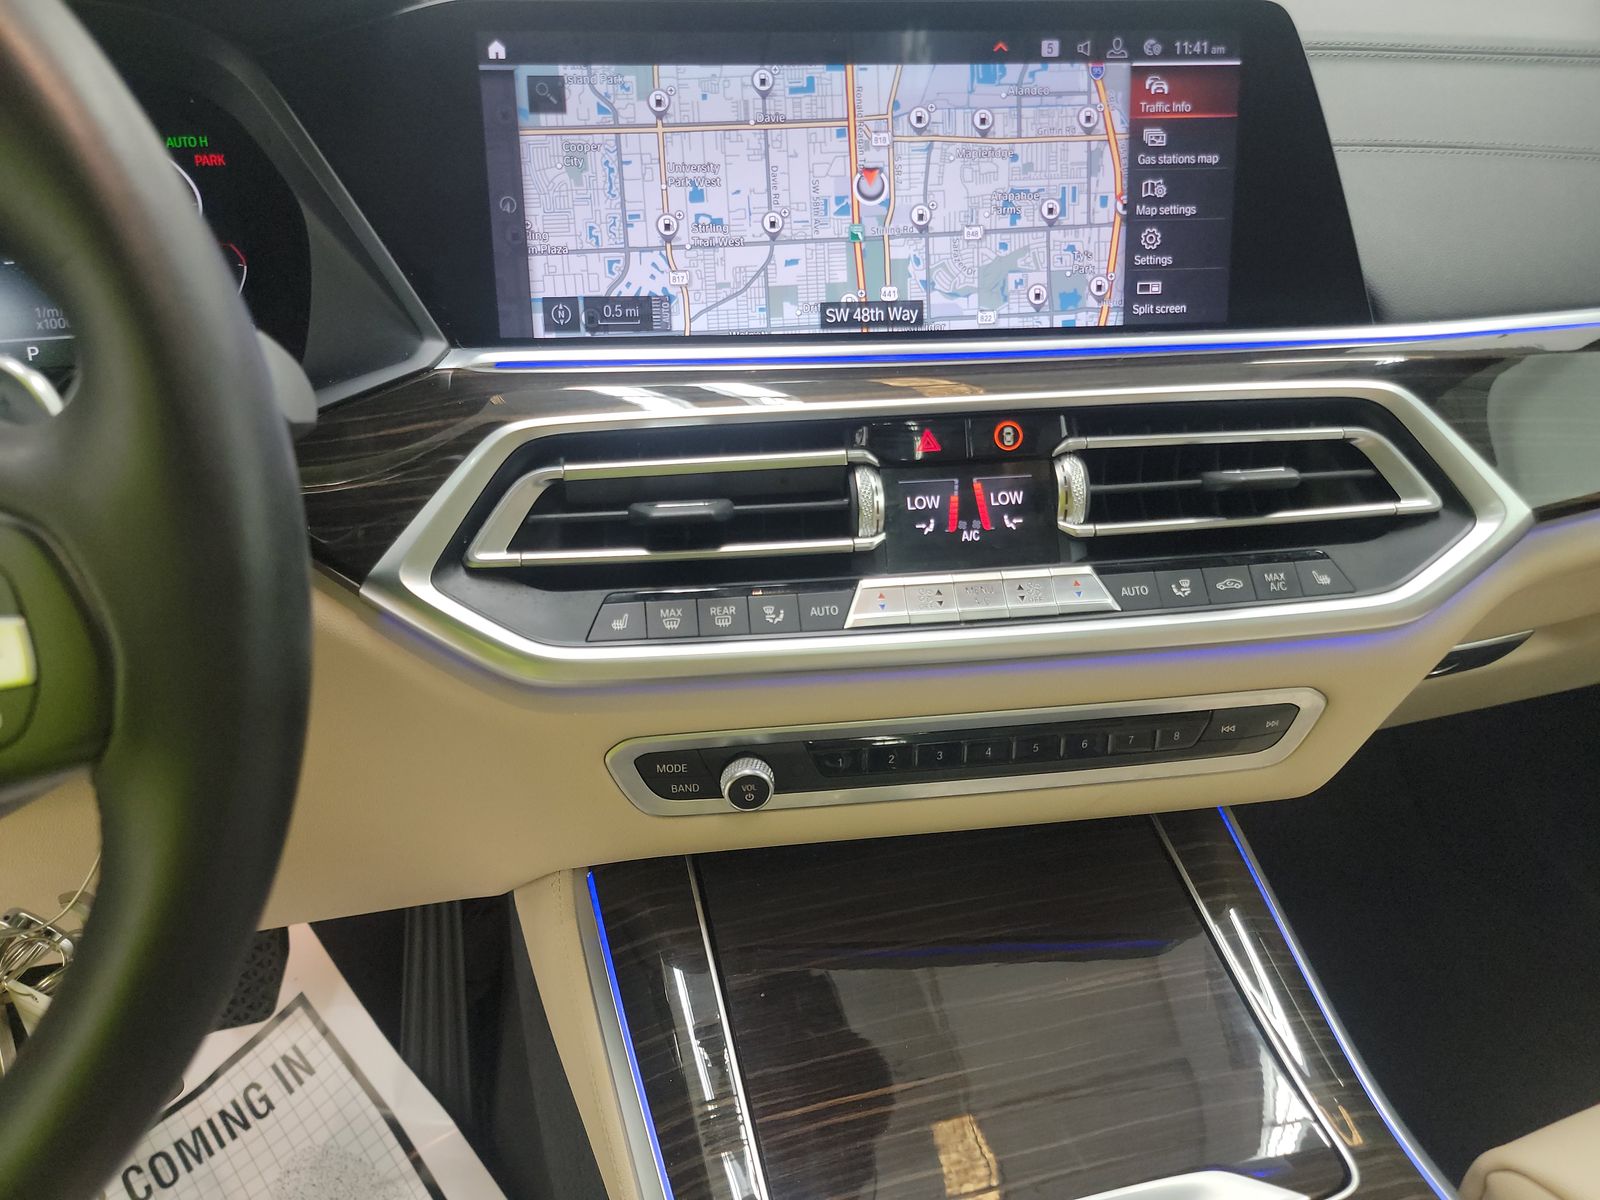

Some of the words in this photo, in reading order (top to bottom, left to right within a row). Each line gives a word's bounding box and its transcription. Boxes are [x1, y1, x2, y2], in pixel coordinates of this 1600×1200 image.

[1046, 42, 1054, 55] 5
[1174, 41, 1209, 55] 11:41
[1211, 46, 1226, 55] am
[600, 73, 625, 85] Park
[1139, 102, 1171, 113] Traffic
[1172, 101, 1192, 112] Info
[755, 112, 787, 123] Davie
[1037, 127, 1063, 136] Griffin
[1065, 127, 1077, 135] Rd
[166, 136, 197, 148] AUTO
[199, 136, 209, 148] H
[562, 141, 602, 154] Cooper
[956, 147, 1015, 160] Mapleridge
[194, 154, 226, 167] PARK
[563, 156, 585, 168] City
[1137, 154, 1157, 166] Gas
[1158, 154, 1196, 165] stations
[1197, 155, 1219, 165] map
[666, 162, 722, 176] University
[668, 176, 692, 188] Park
[693, 176, 722, 188] West
[770, 165, 780, 192] Davie
[811, 179, 821, 192] SW
[772, 193, 781, 206] Rd
[990, 191, 1041, 203] Arapahoe
[990, 205, 1022, 216] Farms
[1135, 205, 1158, 217] Map
[1159, 204, 1197, 217] settings
[690, 223, 729, 235] Stirling
[813, 219, 822, 235] Ave
[902, 225, 914, 234] Rd
[526, 231, 550, 242] ling
[692, 236, 716, 247] Trail
[717, 236, 745, 247] West
[540, 244, 569, 255] Plaza
[1072, 251, 1093, 262] Ty's
[1133, 255, 1174, 267] Settings
[1072, 264, 1096, 275] Park
[671, 274, 685, 284] 817
[881, 289, 896, 298] 441
[603, 304, 623, 318] 0.5
[625, 306, 640, 318] mi
[662, 302, 670, 324] AUTO
[825, 307, 851, 323] SW
[852, 307, 885, 322] 48th
[887, 306, 919, 324] Way
[1132, 303, 1154, 316] Split
[1155, 304, 1187, 315] screen
[26, 346, 40, 361] P
[906, 495, 941, 511] LOW
[989, 491, 1024, 506] LOW
[961, 530, 981, 543] A/C
[1264, 572, 1286, 583] MAX
[1120, 585, 1149, 597] AUTO
[1269, 581, 1288, 592] A/C
[660, 608, 683, 618] MAX
[709, 605, 736, 616] REAR
[809, 605, 839, 617] AUTO
[1127, 734, 1135, 745] 7
[1172, 730, 1181, 741] 8
[1032, 742, 1040, 753] 5
[1080, 738, 1089, 749] 6
[936, 750, 944, 761] 3
[984, 746, 993, 757] 4
[837, 758, 844, 768] 1
[888, 754, 896, 765] 2
[656, 763, 688, 774] MODE
[670, 782, 700, 794] BAND
[741, 784, 757, 792] VOL
[121, 1081, 275, 1200] COMING
[270, 1044, 316, 1096] IN
